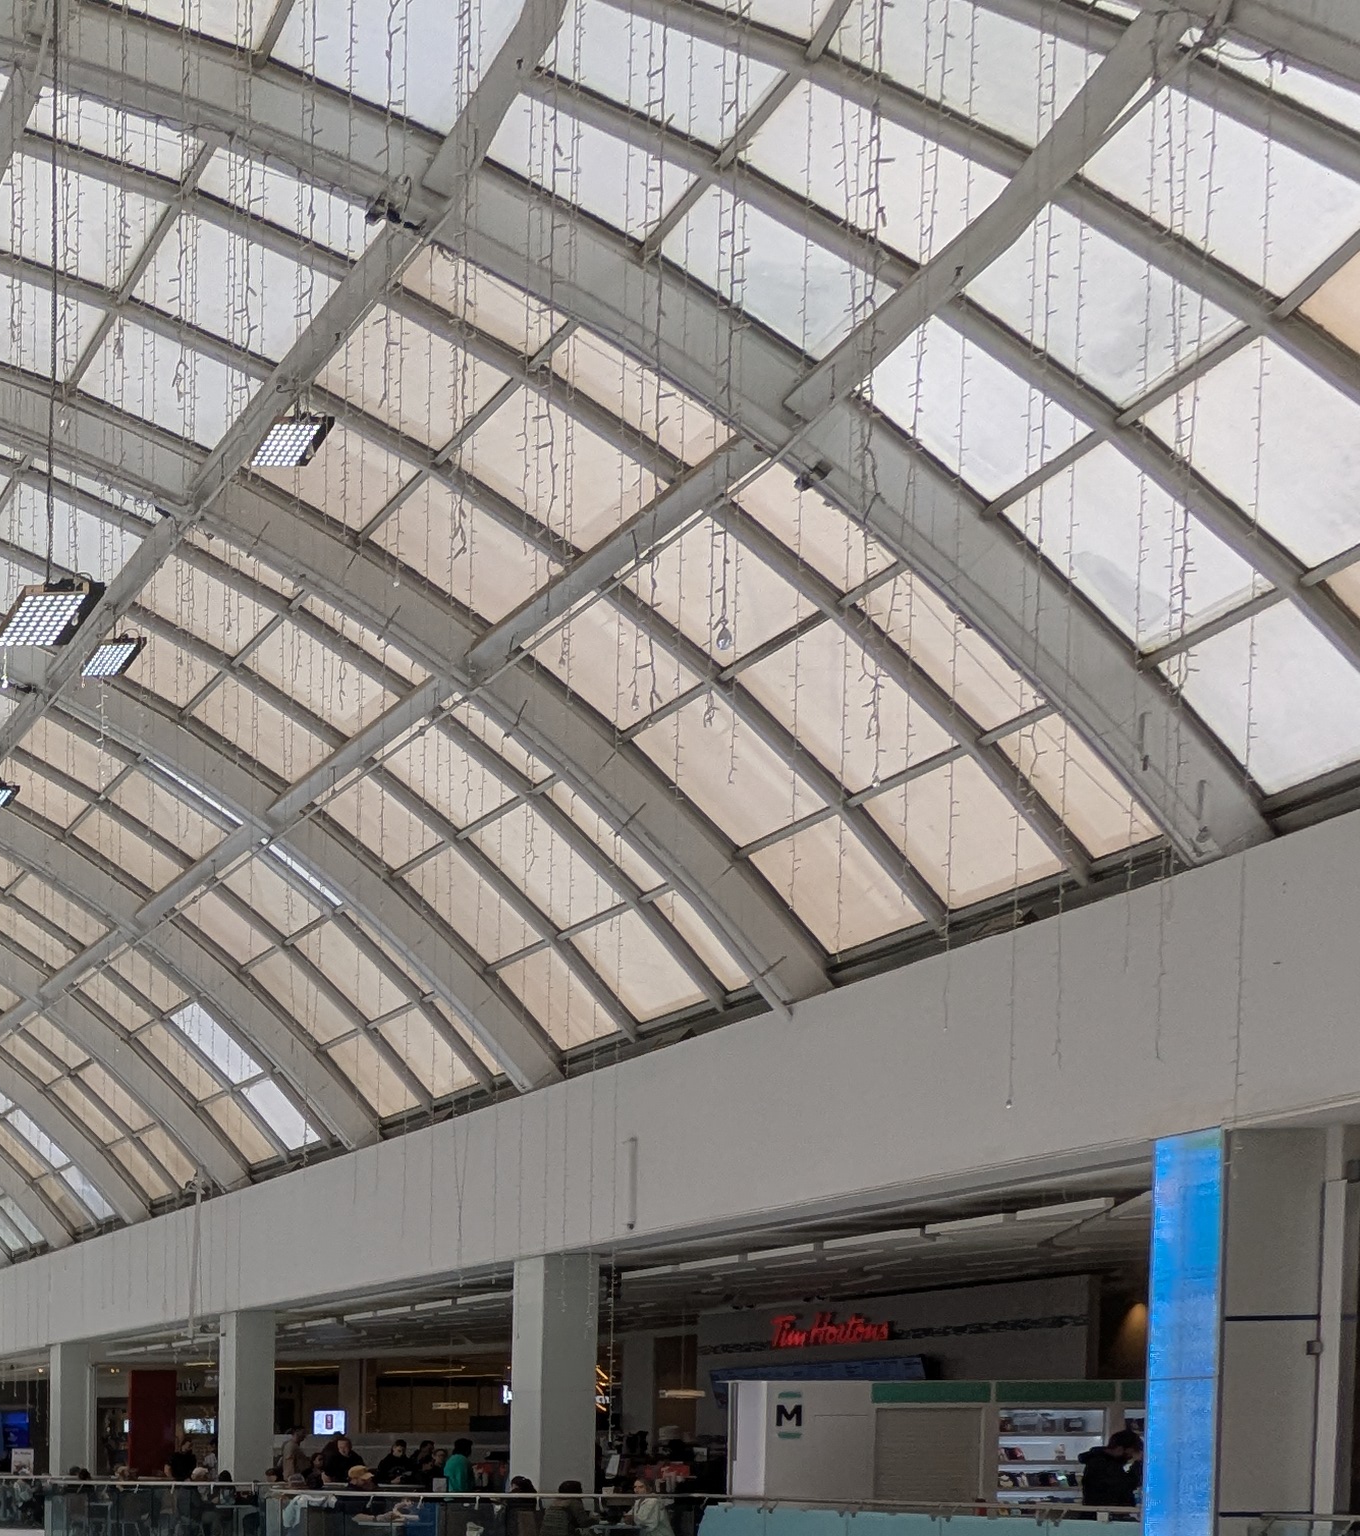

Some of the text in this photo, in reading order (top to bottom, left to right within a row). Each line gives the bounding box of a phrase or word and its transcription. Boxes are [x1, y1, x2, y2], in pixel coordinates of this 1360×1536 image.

[771, 1311, 889, 1348] Tim Hortons
[776, 1404, 802, 1427] M
